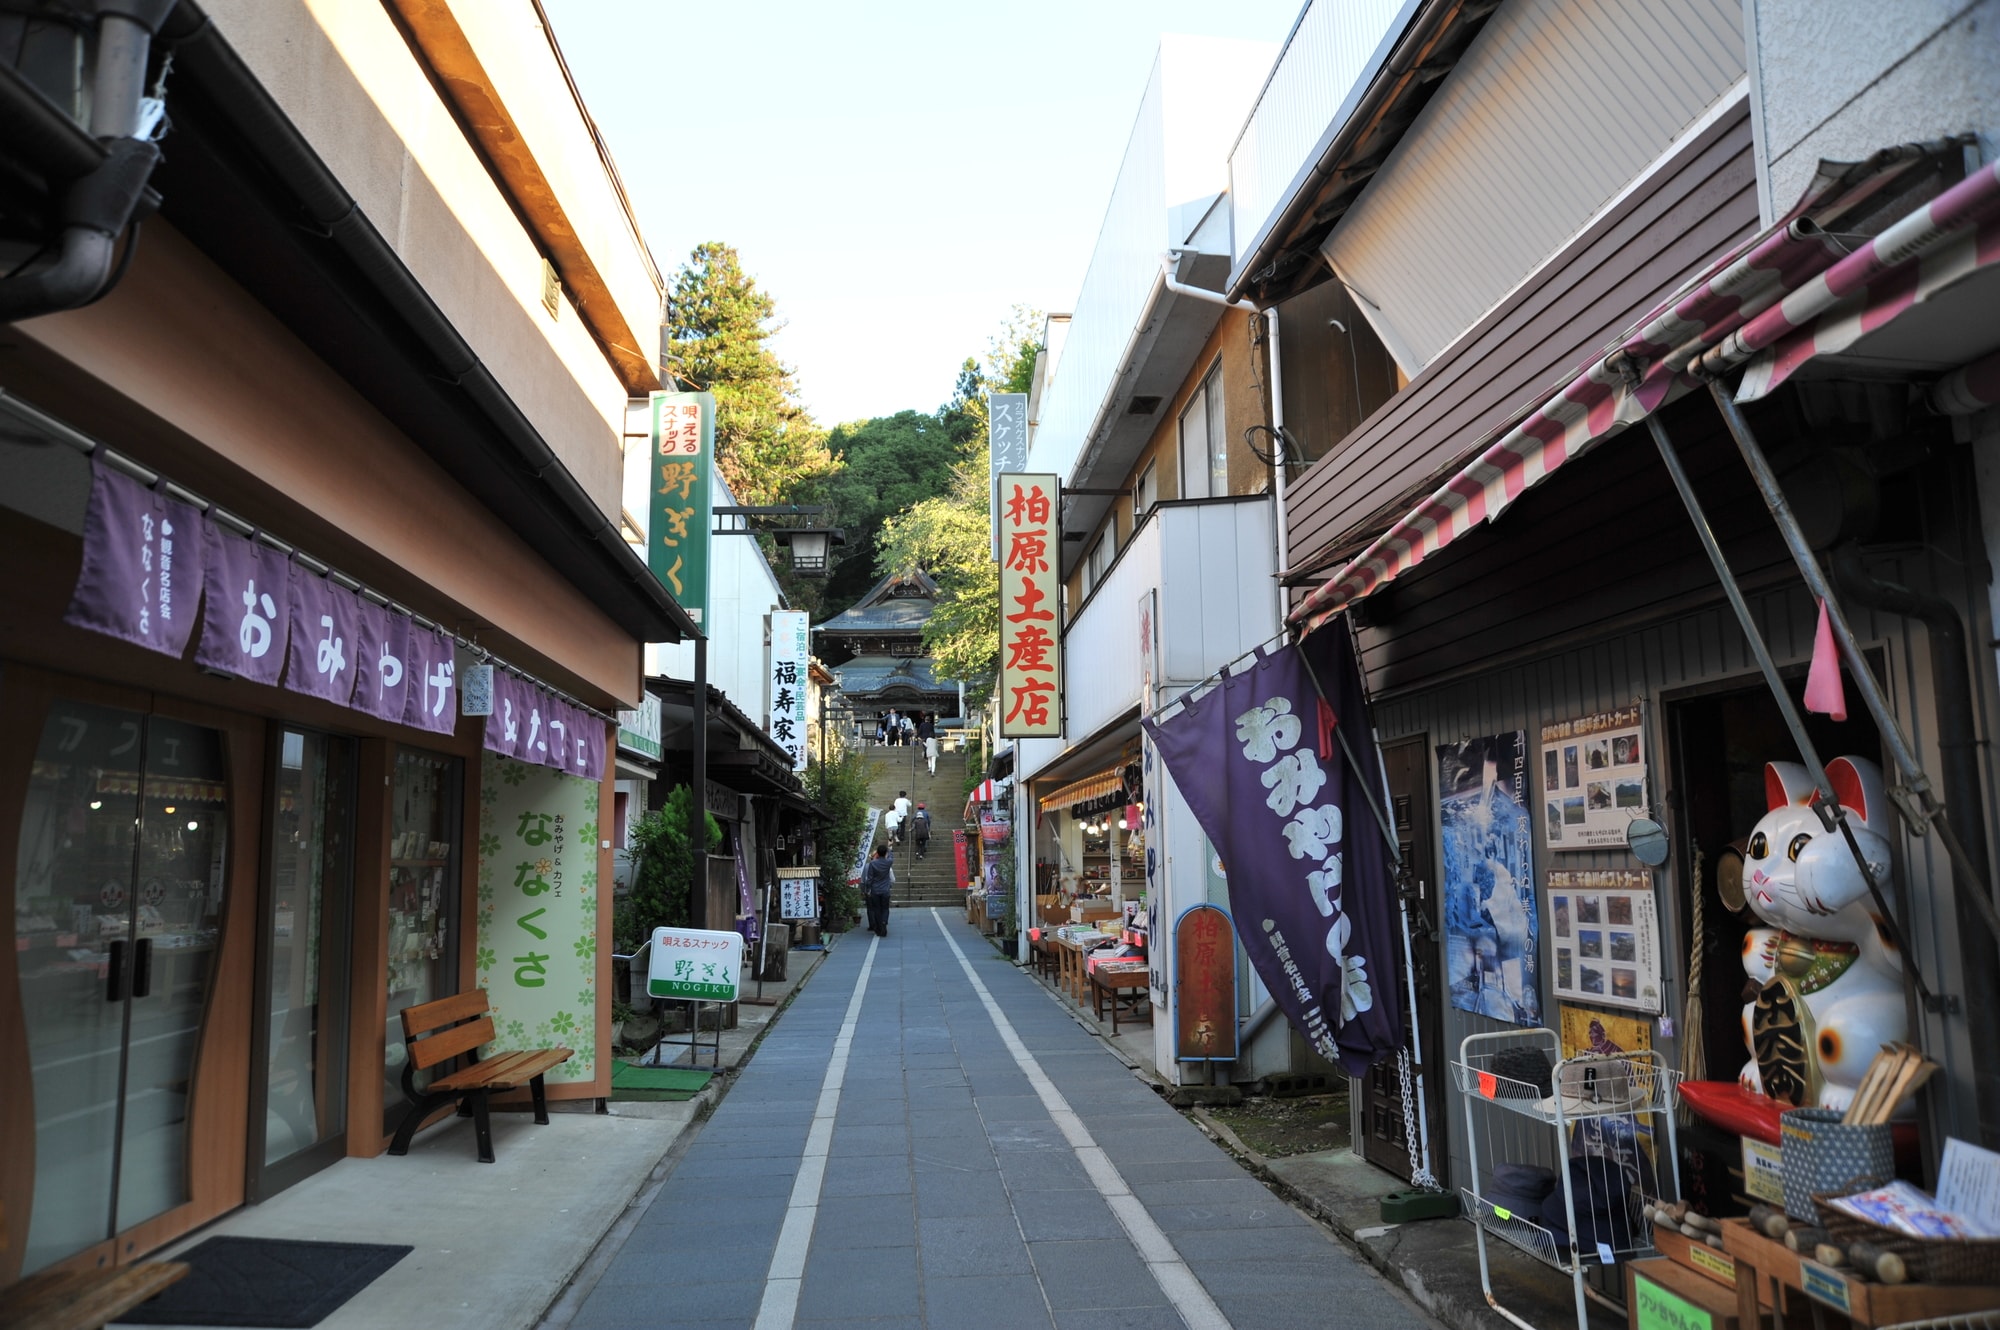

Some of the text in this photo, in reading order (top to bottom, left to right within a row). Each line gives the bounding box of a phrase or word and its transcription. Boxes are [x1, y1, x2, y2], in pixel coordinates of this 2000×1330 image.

[662, 405, 679, 454] スナック
[682, 405, 698, 454] 唄える
[1015, 401, 1026, 472] カラオケスナック
[658, 460, 698, 597] 野ぎく
[1003, 483, 1056, 727] 柏原土産店
[239, 578, 455, 717] おみやげ
[772, 660, 798, 743] 福寿家
[552, 813, 565, 899] おみやげ & カフェ
[513, 810, 554, 989] ななくさ
[662, 936, 730, 950] 唄えるスナック
[673, 959, 731, 984] 野ぎく
[1267, 928, 1314, 1005] 観音名店会
[671, 981, 732, 994] NOGIKU
